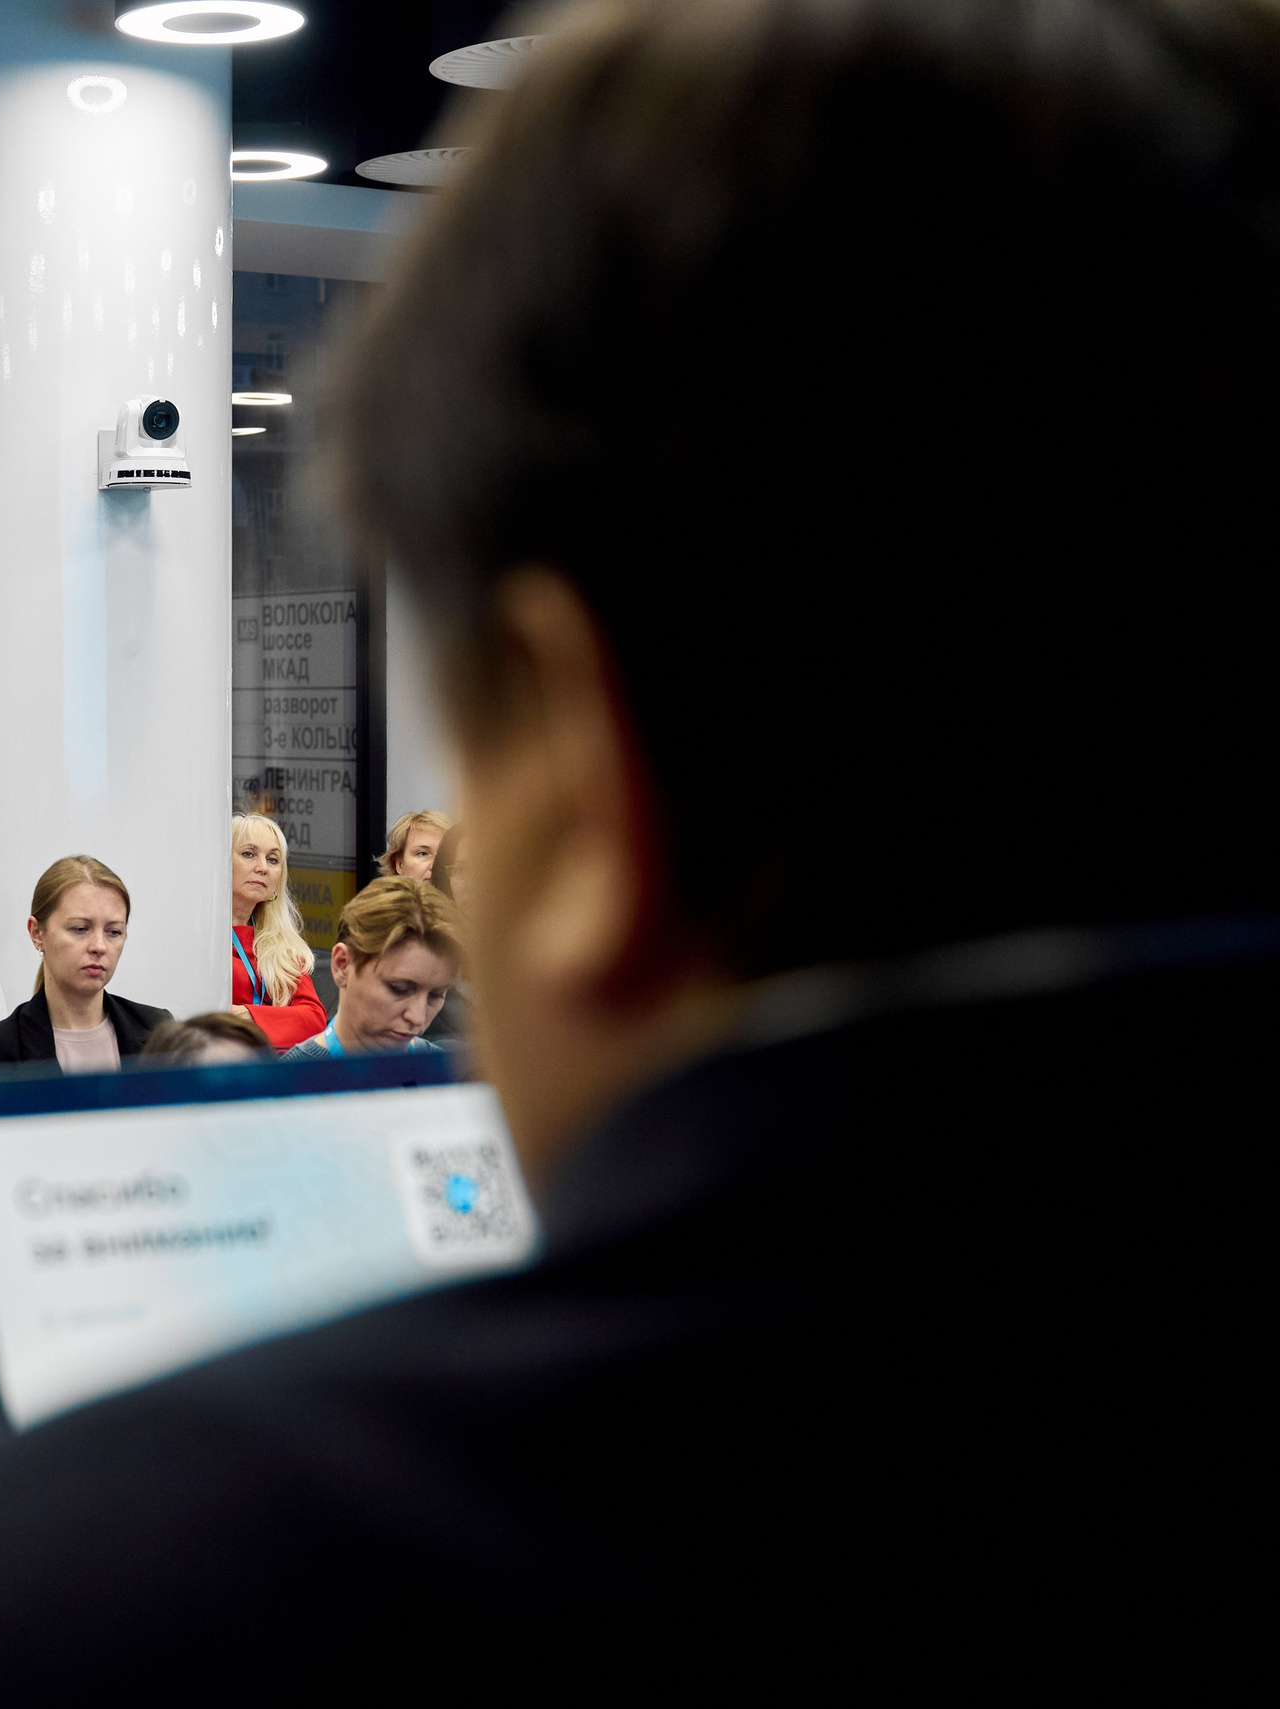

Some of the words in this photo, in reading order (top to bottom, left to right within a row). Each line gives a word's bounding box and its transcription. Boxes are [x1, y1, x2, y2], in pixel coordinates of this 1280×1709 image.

[262, 656, 310, 684] МКАД
[264, 697, 338, 720] разворот
[263, 767, 357, 797] ЛЕНИНГРА
